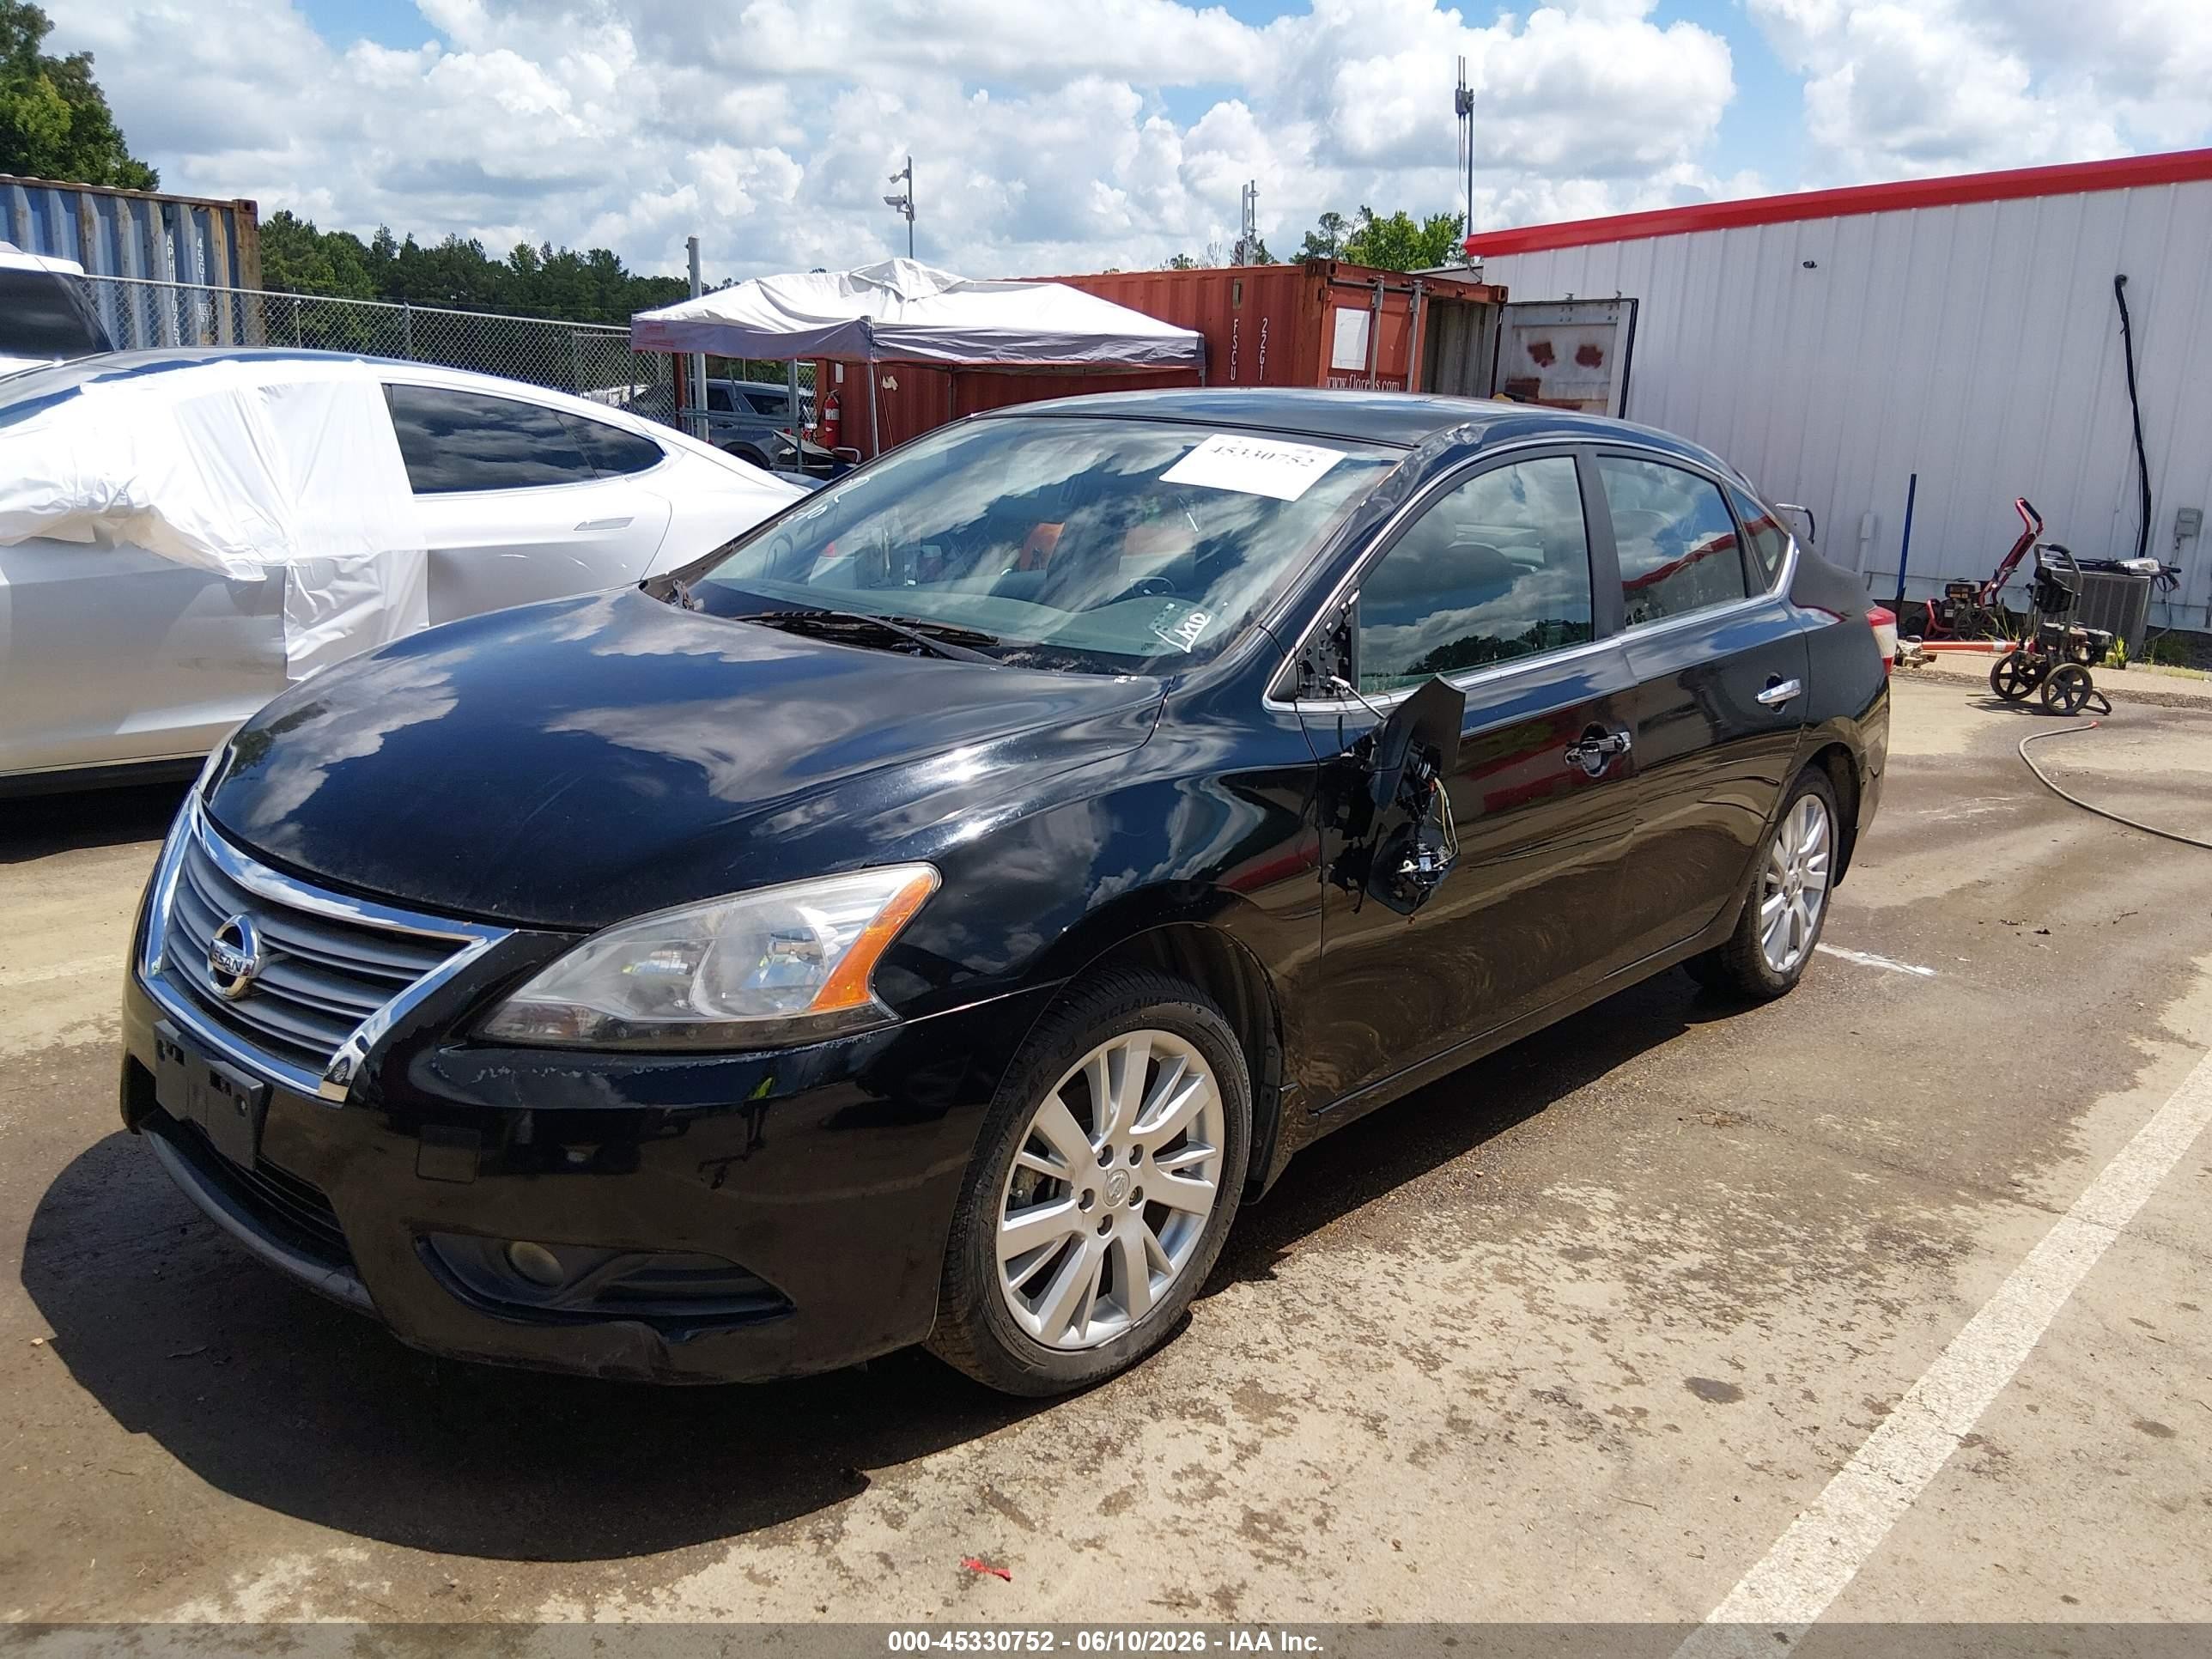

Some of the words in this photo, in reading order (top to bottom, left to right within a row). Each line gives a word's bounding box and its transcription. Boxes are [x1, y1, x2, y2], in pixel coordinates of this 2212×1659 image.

[197, 237, 205, 286] 45G1
[1231, 318, 1239, 380] FSCU
[1260, 318, 1268, 380] 22G1
[1326, 374, 1400, 392] www.florescom
[211, 947, 243, 973] SSAN
